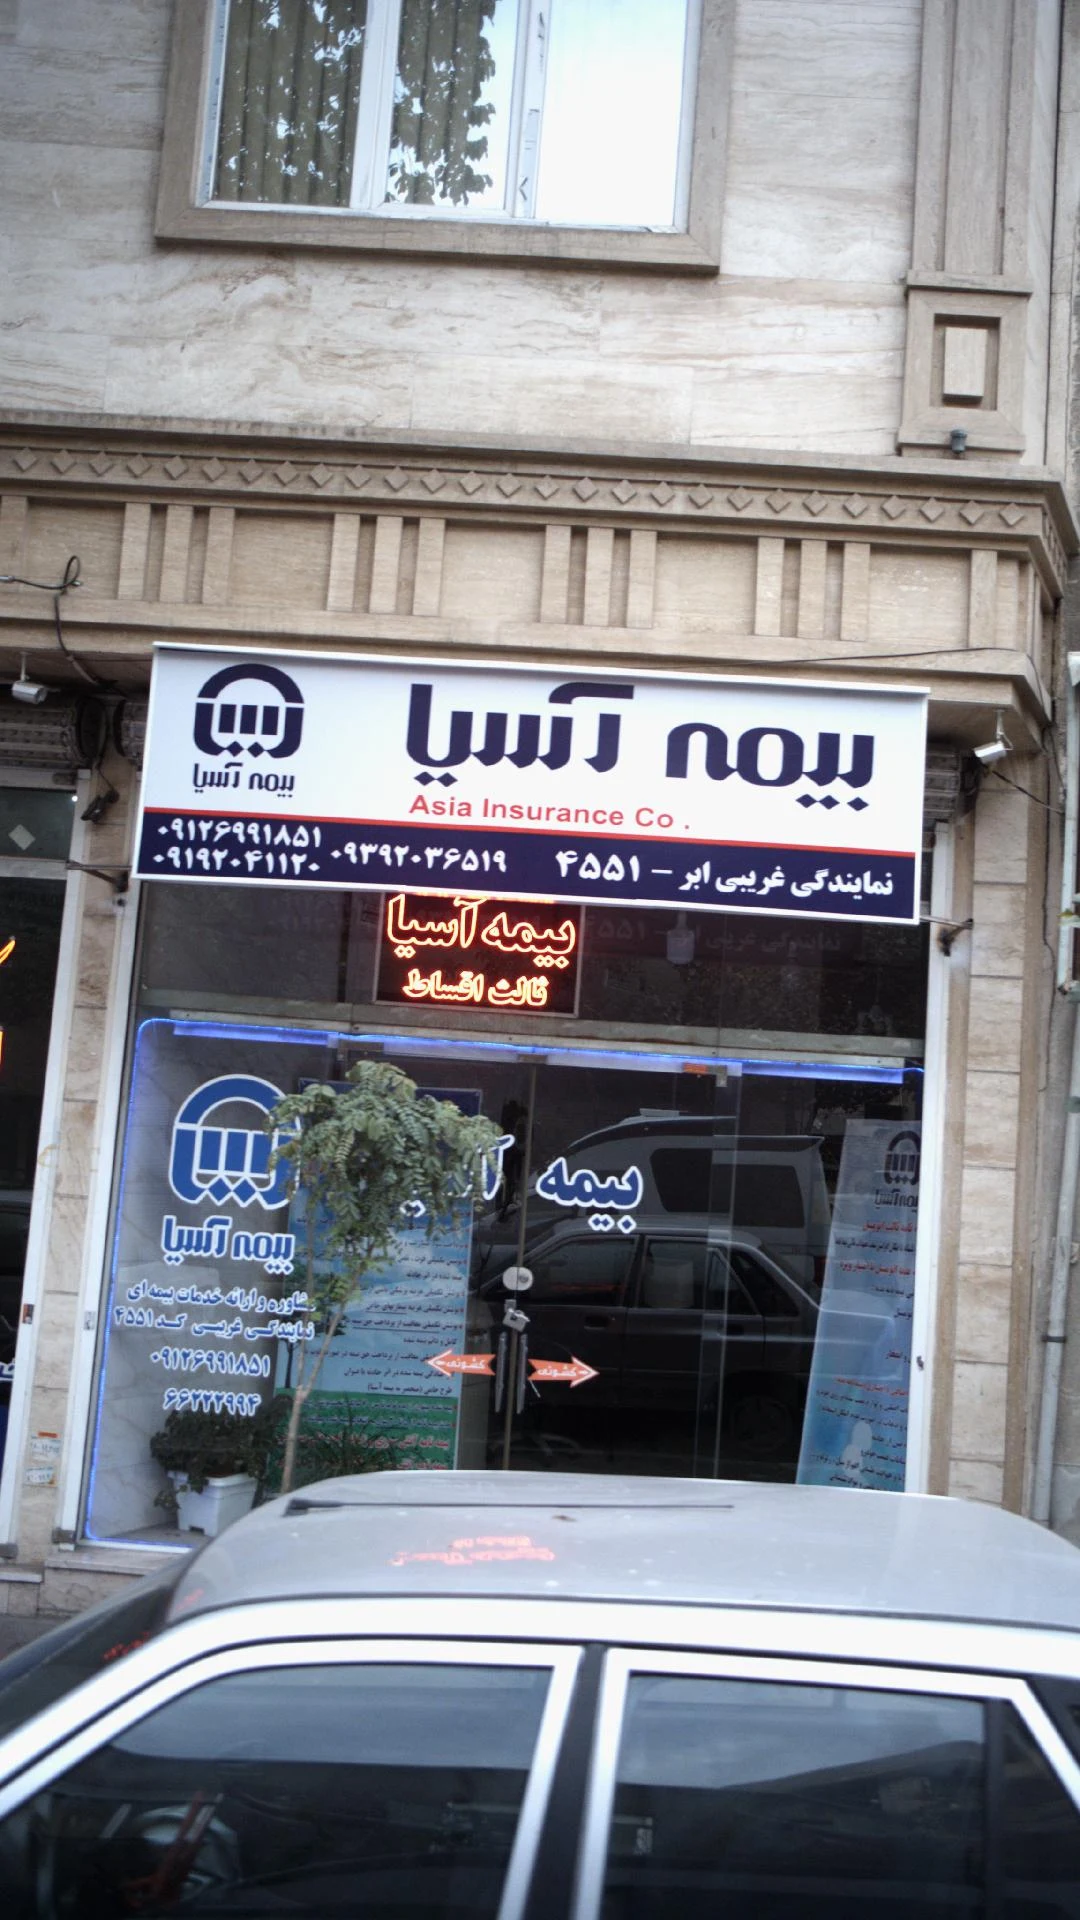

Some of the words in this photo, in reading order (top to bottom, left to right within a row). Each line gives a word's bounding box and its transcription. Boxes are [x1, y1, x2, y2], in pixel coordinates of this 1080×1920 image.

[406, 682, 634, 787] آسیا
[193, 762, 243, 793] آسیا
[666, 723, 875, 811] بیمه
[248, 773, 295, 798] بیمه
[409, 795, 472, 817] Asia
[483, 798, 624, 826] Insurance
[158, 818, 321, 848] ۰۹۱۲۶۹۹۱۸۵۱
[152, 846, 321, 875] ۰۹۱۹۲۰۴۱۱۲۰
[330, 842, 507, 873] ۰۹۳۹۲۰۳۶۵۱۹
[555, 849, 641, 883] ۴۵۵۱
[678, 861, 711, 890] ابر
[715, 865, 786, 895] غریبی
[790, 869, 893, 900] نمایندگی
[387, 893, 487, 958] آسیا
[481, 911, 576, 969] بیمه
[402, 968, 485, 1002] اقساط
[535, 1156, 643, 1233] بیمه
[161, 1214, 233, 1265] آسیا
[231, 1230, 296, 1275] بیمه
[127, 1279, 148, 1301] ای
[149, 1285, 174, 1304] بیمه
[177, 1284, 223, 1305] خدمات
[255, 1297, 265, 1313] و
[114, 1305, 154, 1328] ۴۵۵۱
[155, 1312, 188, 1331] کد
[191, 1317, 244, 1339] غریبی
[150, 1346, 271, 1377] ۰۹۱۲۶۹۹۱۸۵۱
[162, 1387, 262, 1417] ۶۶۲۲۲۹۹۴
